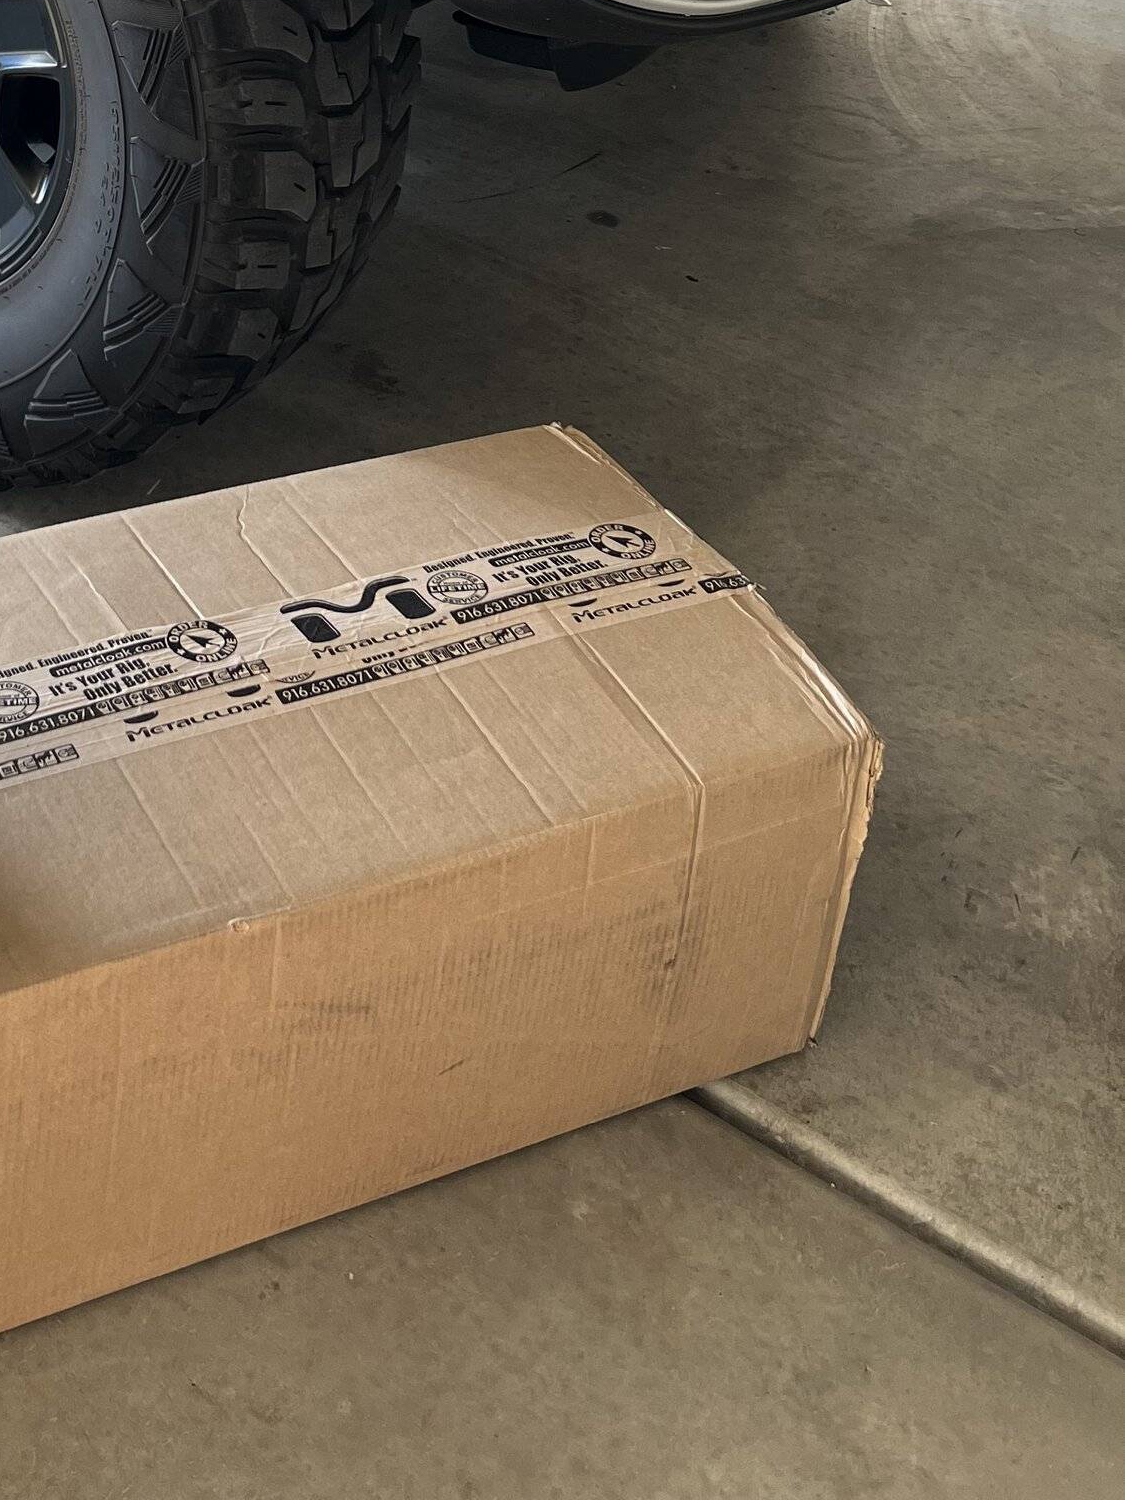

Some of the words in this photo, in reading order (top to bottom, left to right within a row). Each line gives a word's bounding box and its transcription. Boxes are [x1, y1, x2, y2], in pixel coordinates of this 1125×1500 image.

[492, 569, 520, 583] It's
[518, 560, 554, 576] Your
[526, 570, 561, 587] Only
[562, 557, 609, 578] Better.
[457, 591, 542, 623] 916.631.8071
[169, 620, 209, 643] ORDER
[55, 640, 165, 677] metalcloak.com
[195, 637, 238, 662] ONLINE
[49, 681, 76, 697] It's
[75, 668, 116, 689] Your
[83, 681, 122, 702] Only
[123, 662, 178, 688] Better.
[282, 669, 375, 702] 916.631.8071
